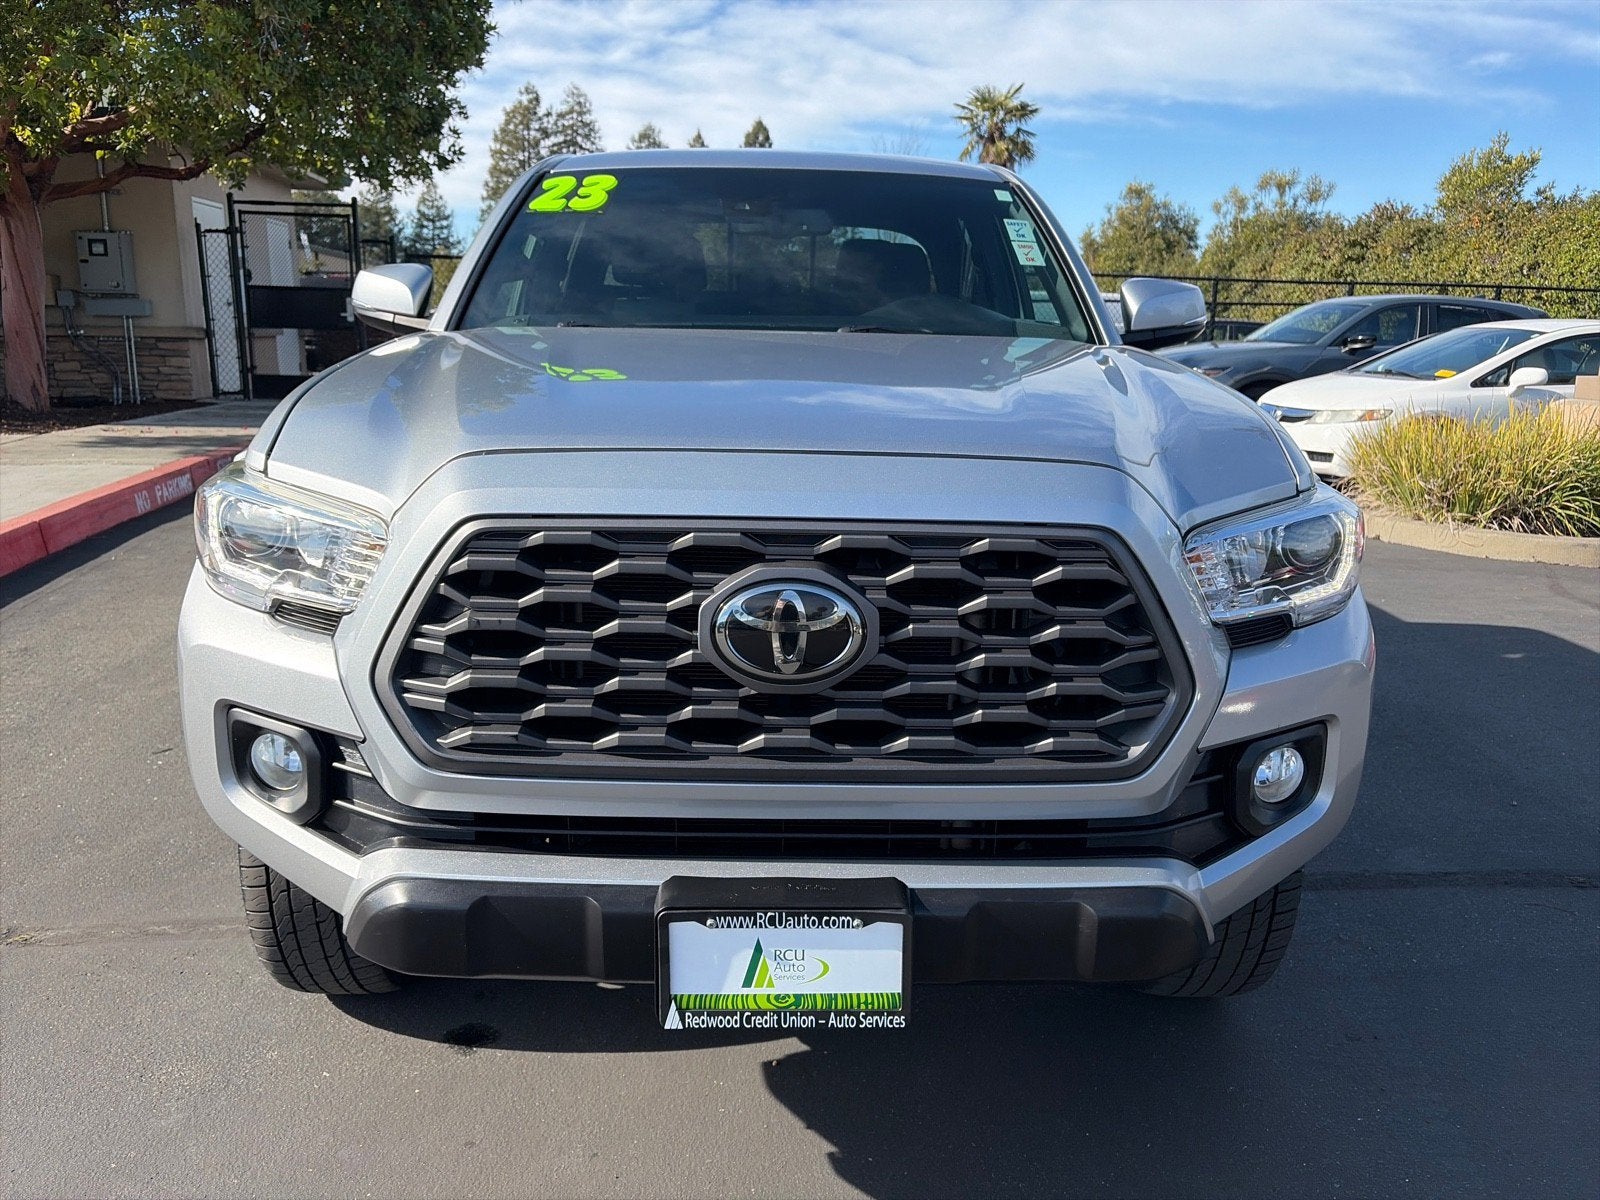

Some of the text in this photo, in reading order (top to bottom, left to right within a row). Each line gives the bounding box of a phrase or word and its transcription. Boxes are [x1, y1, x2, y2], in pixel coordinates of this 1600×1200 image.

[528, 174, 618, 212] 23
[134, 474, 193, 514] NO PARKING
[716, 911, 853, 929] www.RCUauto.com
[774, 949, 805, 962] RCU
[773, 961, 806, 973] Auto
[773, 973, 806, 981] Services
[685, 1011, 740, 1029] Redwood
[742, 1011, 779, 1029] Credit
[781, 1011, 816, 1029] Union
[828, 1011, 857, 1029] Auto
[859, 1011, 906, 1029] Services
